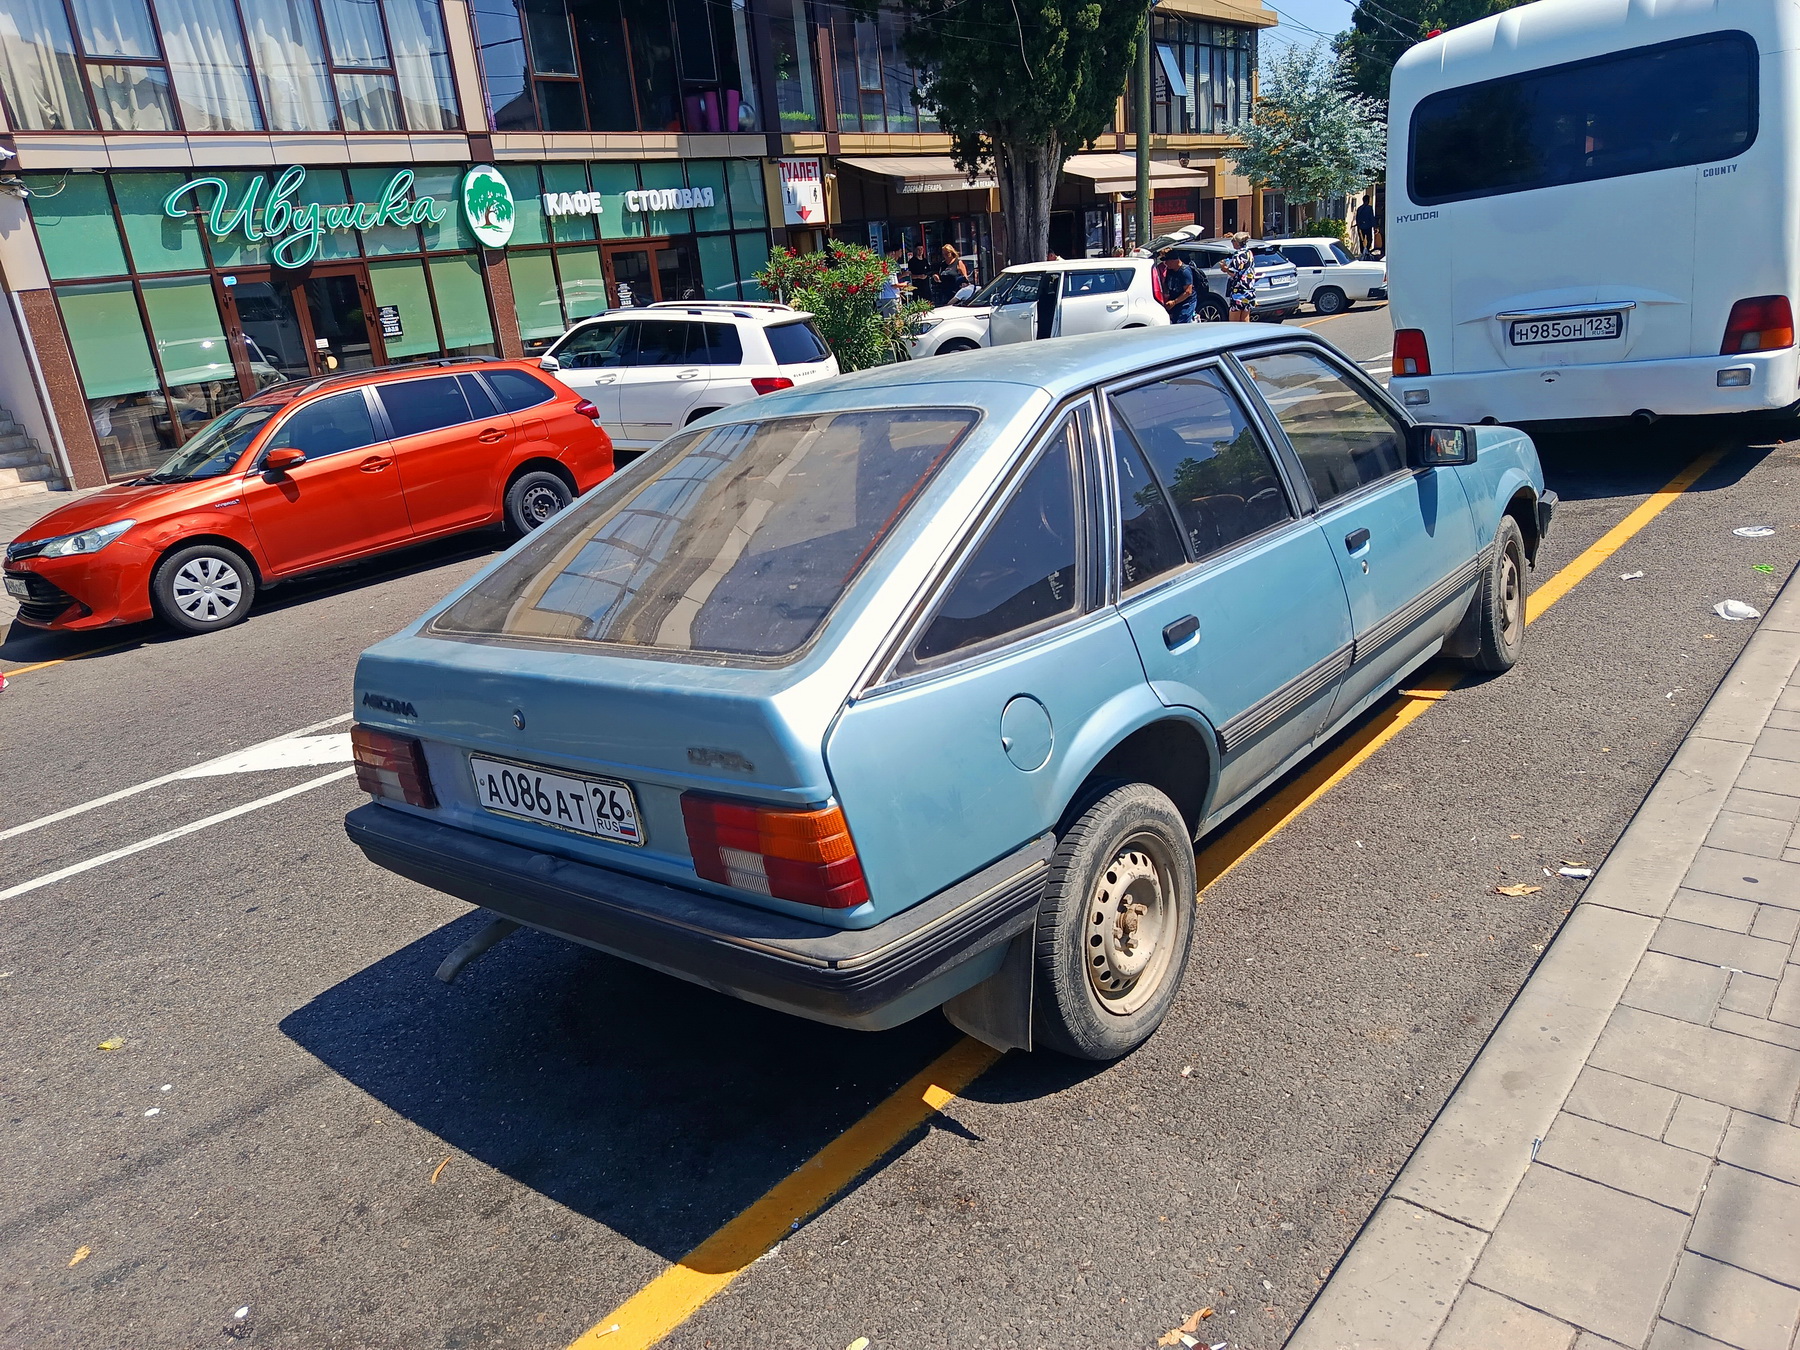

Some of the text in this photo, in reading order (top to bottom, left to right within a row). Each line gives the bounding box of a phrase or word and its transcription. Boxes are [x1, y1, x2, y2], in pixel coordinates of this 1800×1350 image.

[779, 161, 818, 183] ТУАЛЕТ
[1703, 164, 1738, 178] COUNTY
[903, 183, 943, 194] ДОБРЫЙ ПЕКАРЬ
[543, 186, 715, 217] КАФЕ СТОЛОВАЯ
[164, 165, 446, 269] Ивушка
[1396, 211, 1439, 223] HYUNDAI
[1520, 317, 1613, 341] Н985ОН 123
[488, 770, 625, 825] А086АТ 26
[596, 819, 620, 833] RUS
